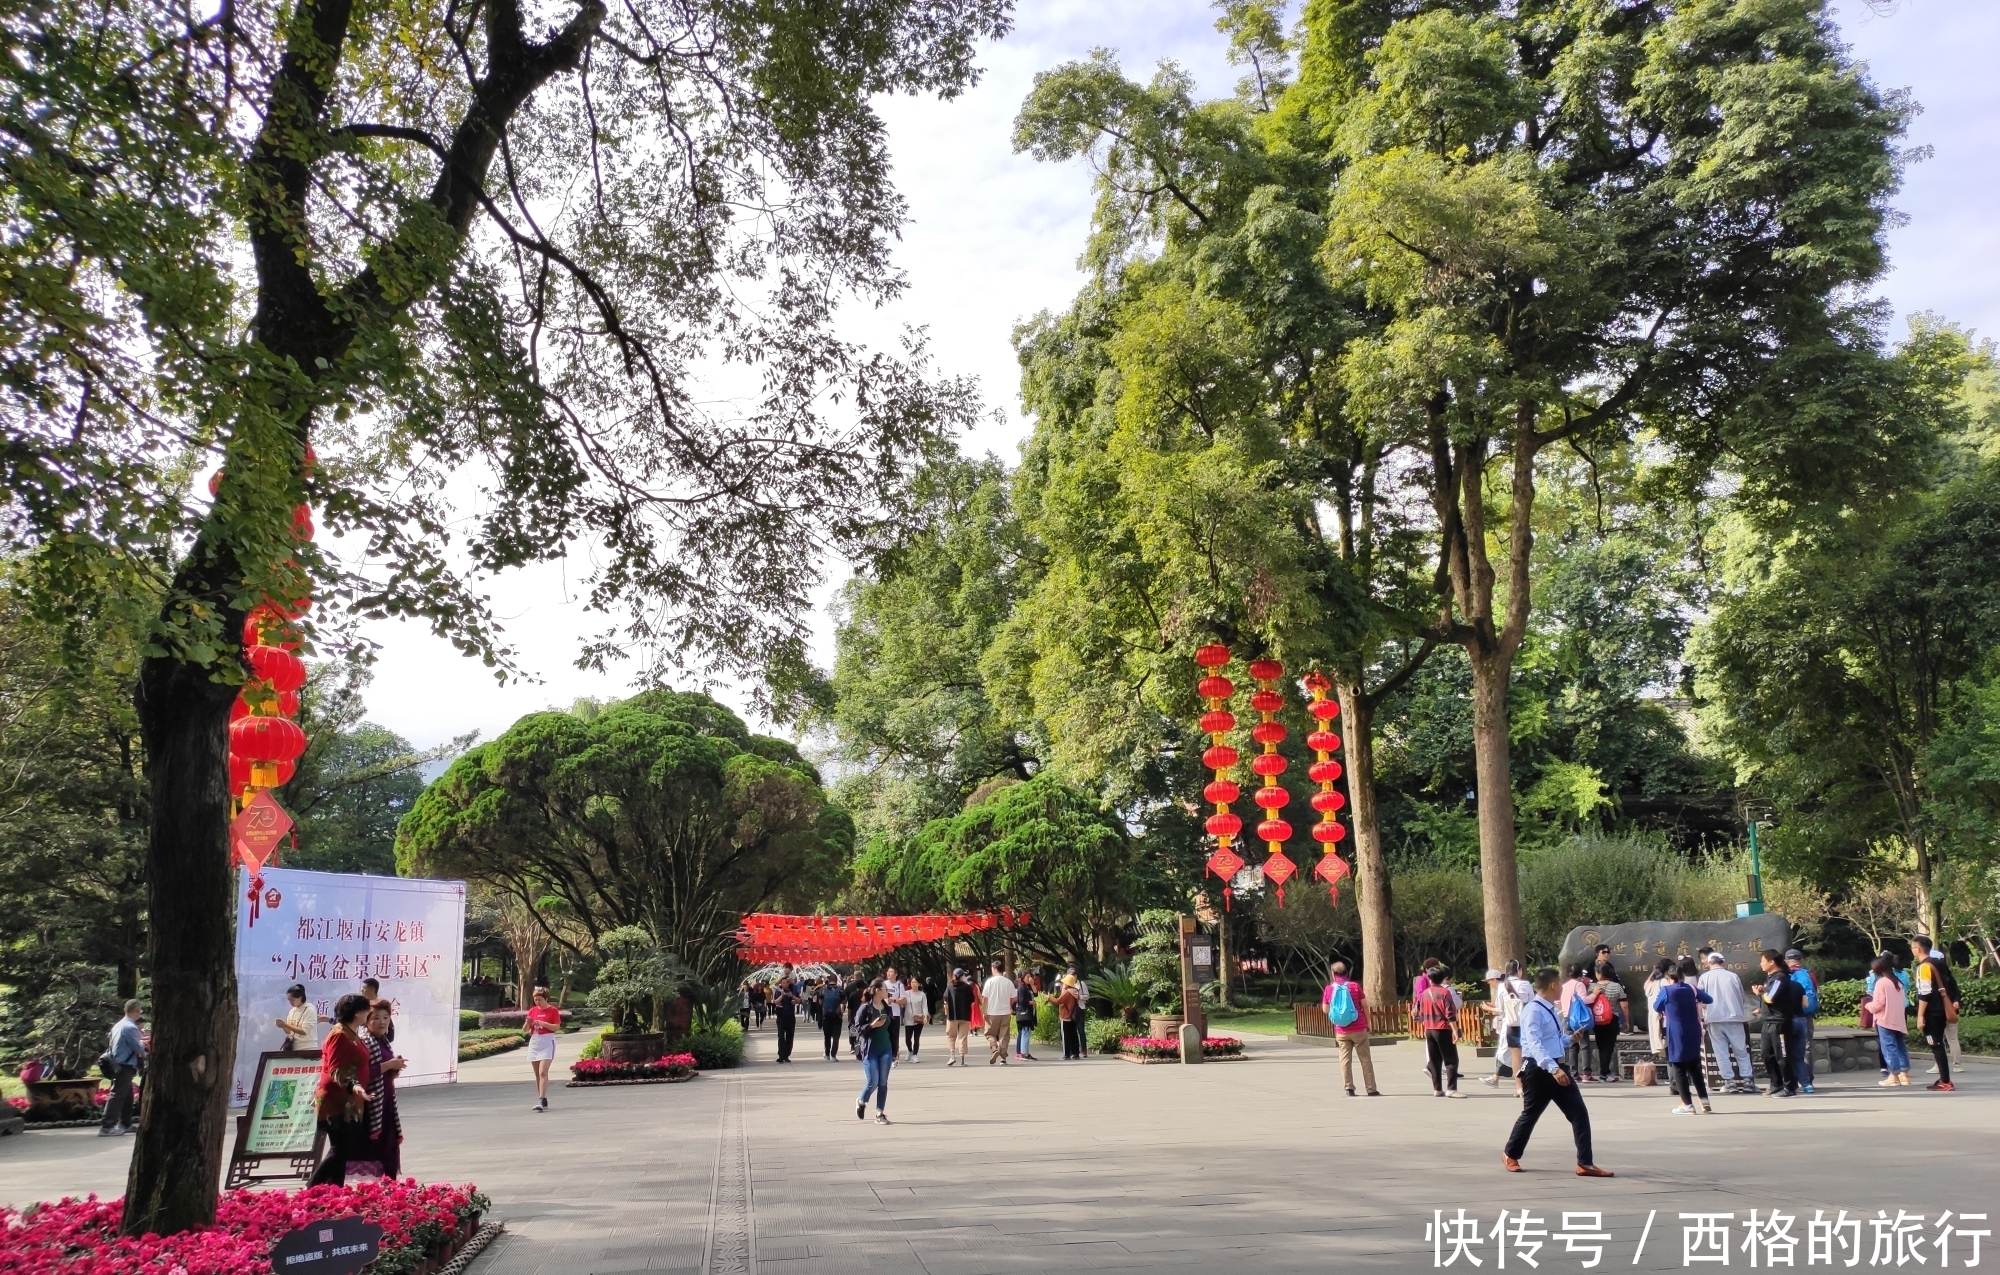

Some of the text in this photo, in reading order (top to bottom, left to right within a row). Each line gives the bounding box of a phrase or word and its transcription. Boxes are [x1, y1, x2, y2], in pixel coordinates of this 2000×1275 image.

[247, 805, 278, 829] 70
[297, 917, 425, 942] 都江堰市安龙镇
